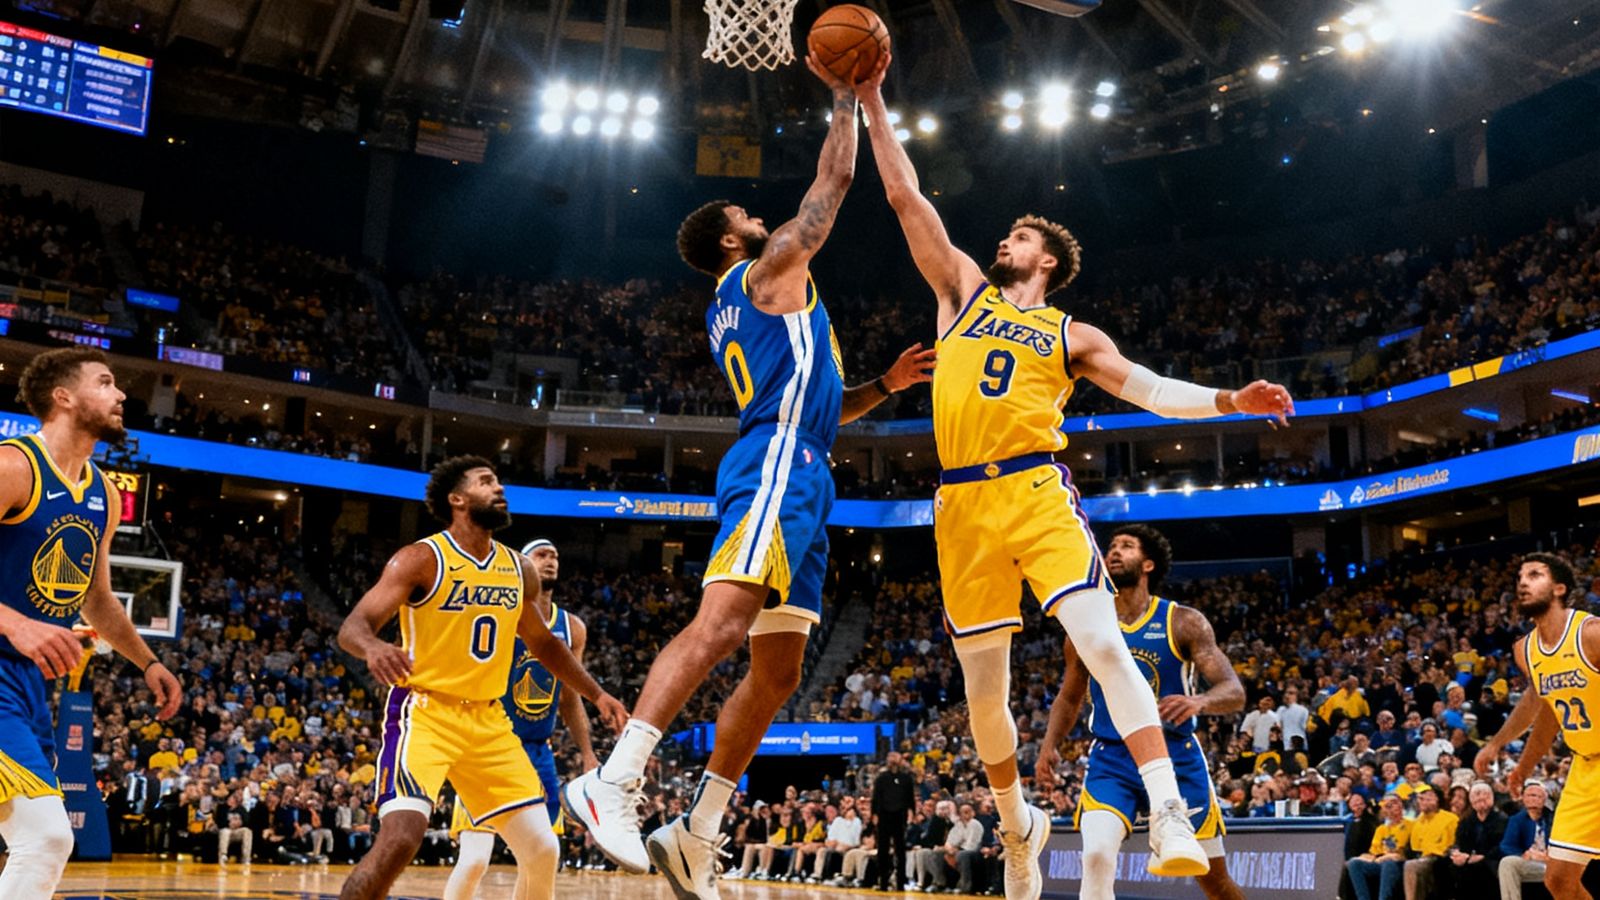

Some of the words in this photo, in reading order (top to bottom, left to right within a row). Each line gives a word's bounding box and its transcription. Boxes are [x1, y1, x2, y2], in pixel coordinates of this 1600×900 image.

[960, 307, 1057, 357] LAKERS
[724, 340, 755, 411] 0
[979, 348, 1017, 398] 9
[471, 615, 497, 662] 0
[1555, 697, 1592, 730] 23
